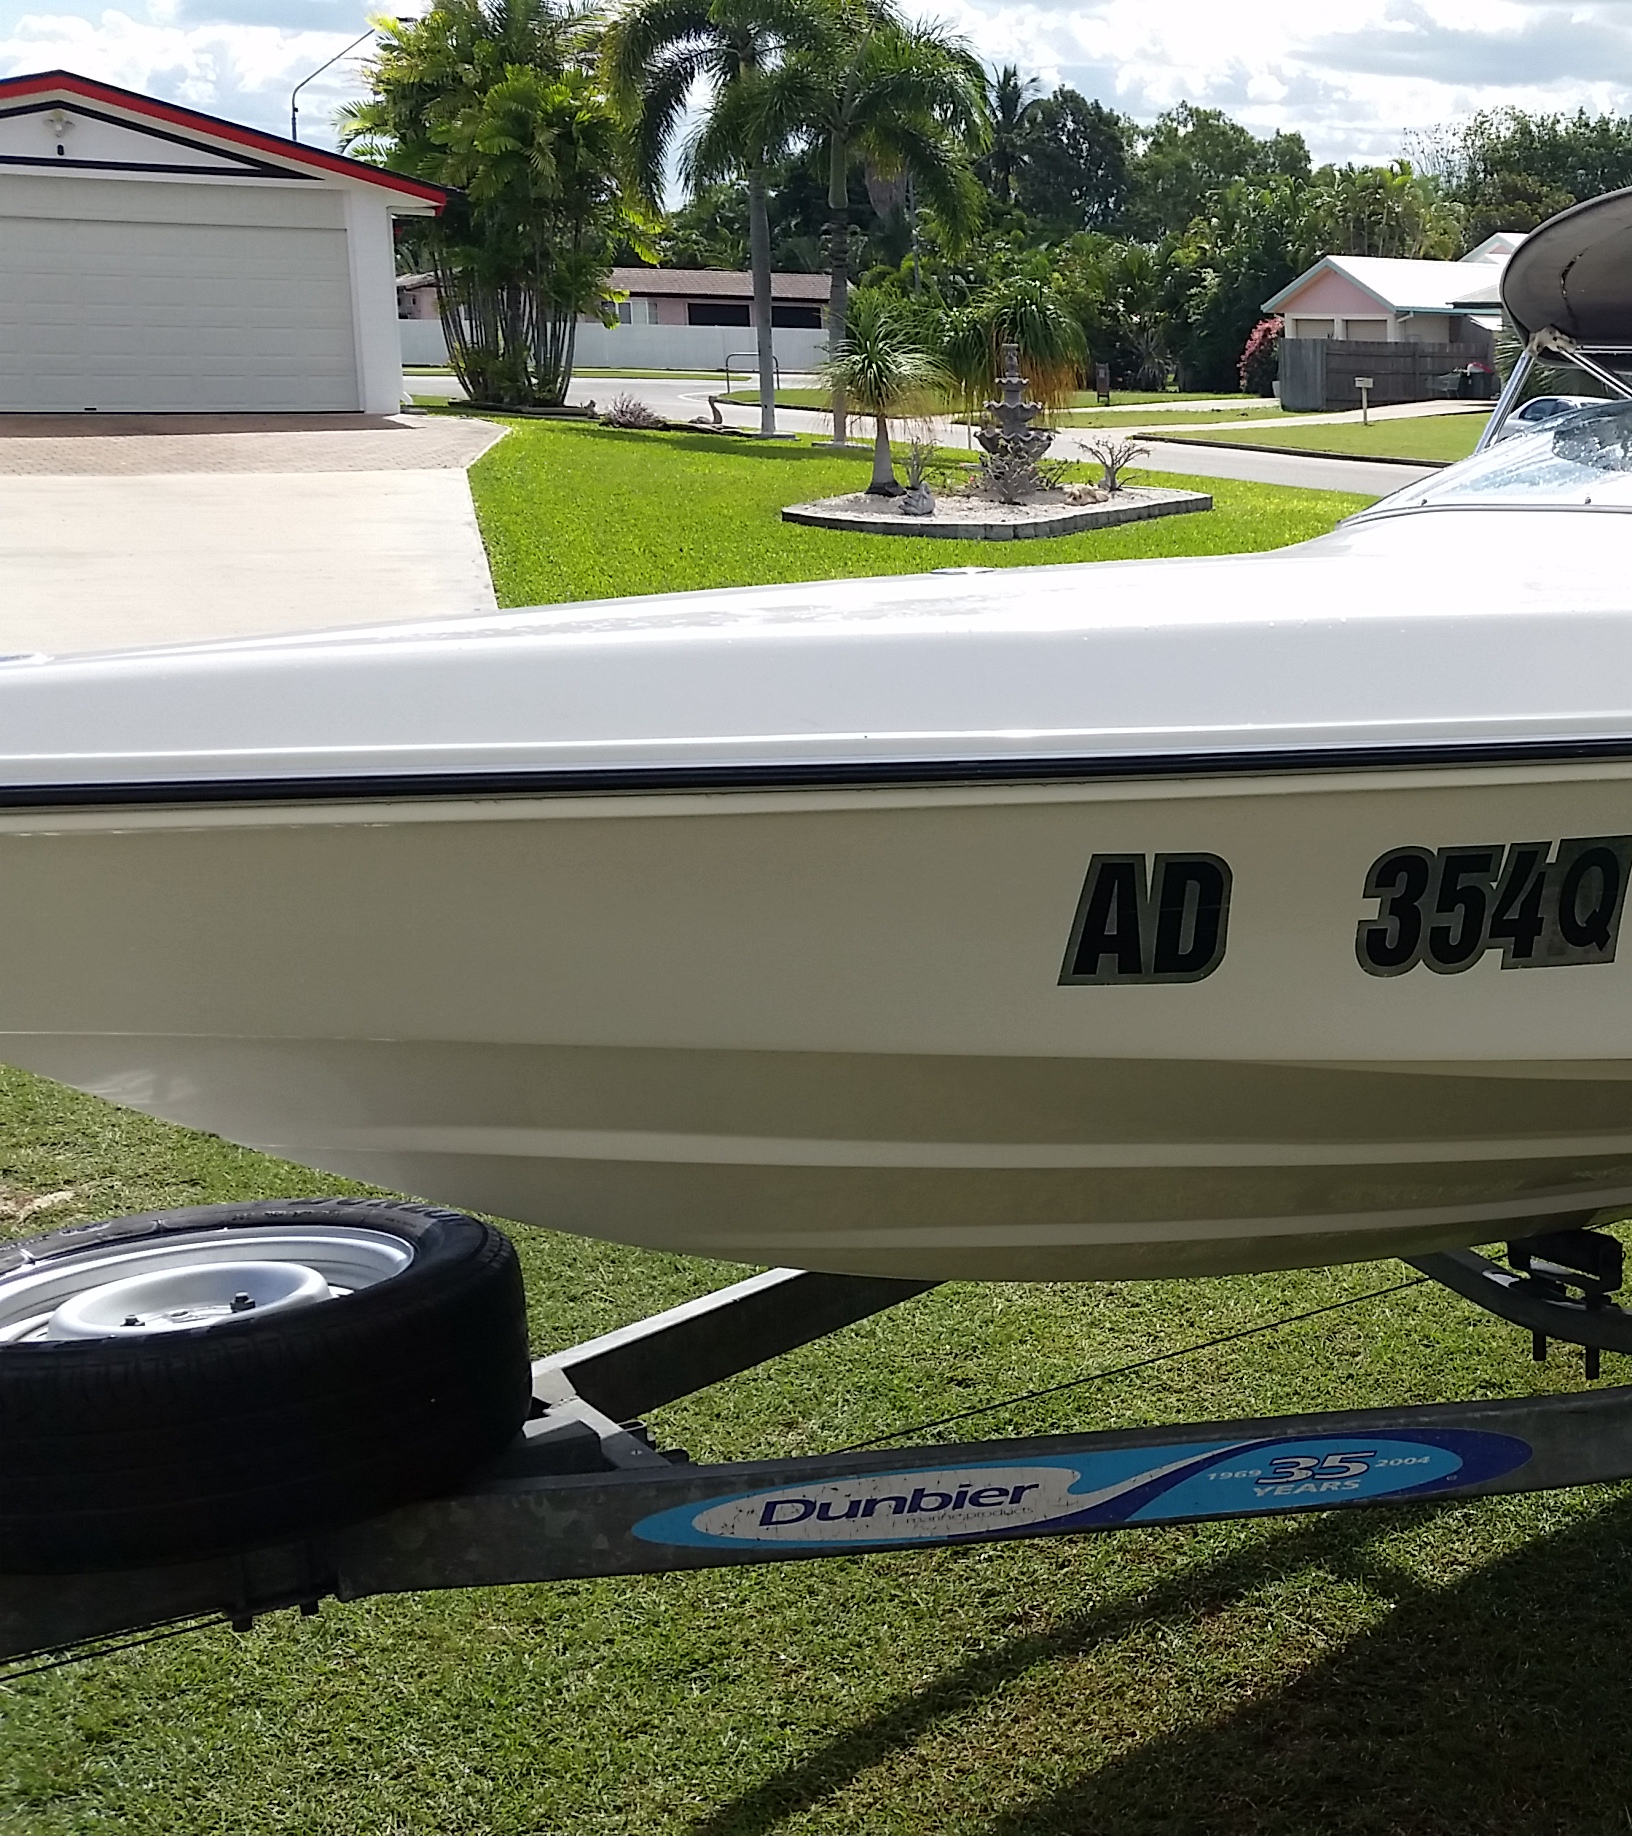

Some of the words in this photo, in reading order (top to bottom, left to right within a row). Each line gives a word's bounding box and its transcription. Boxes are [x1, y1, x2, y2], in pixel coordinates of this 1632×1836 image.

[1060, 853, 1232, 985] AD
[1207, 1469, 1262, 1481] 1969
[1255, 1451, 1379, 1485] 35
[1374, 1456, 1431, 1468] 2004
[758, 1483, 1040, 1527] Dunbier
[1253, 1480, 1361, 1497] YEARS
